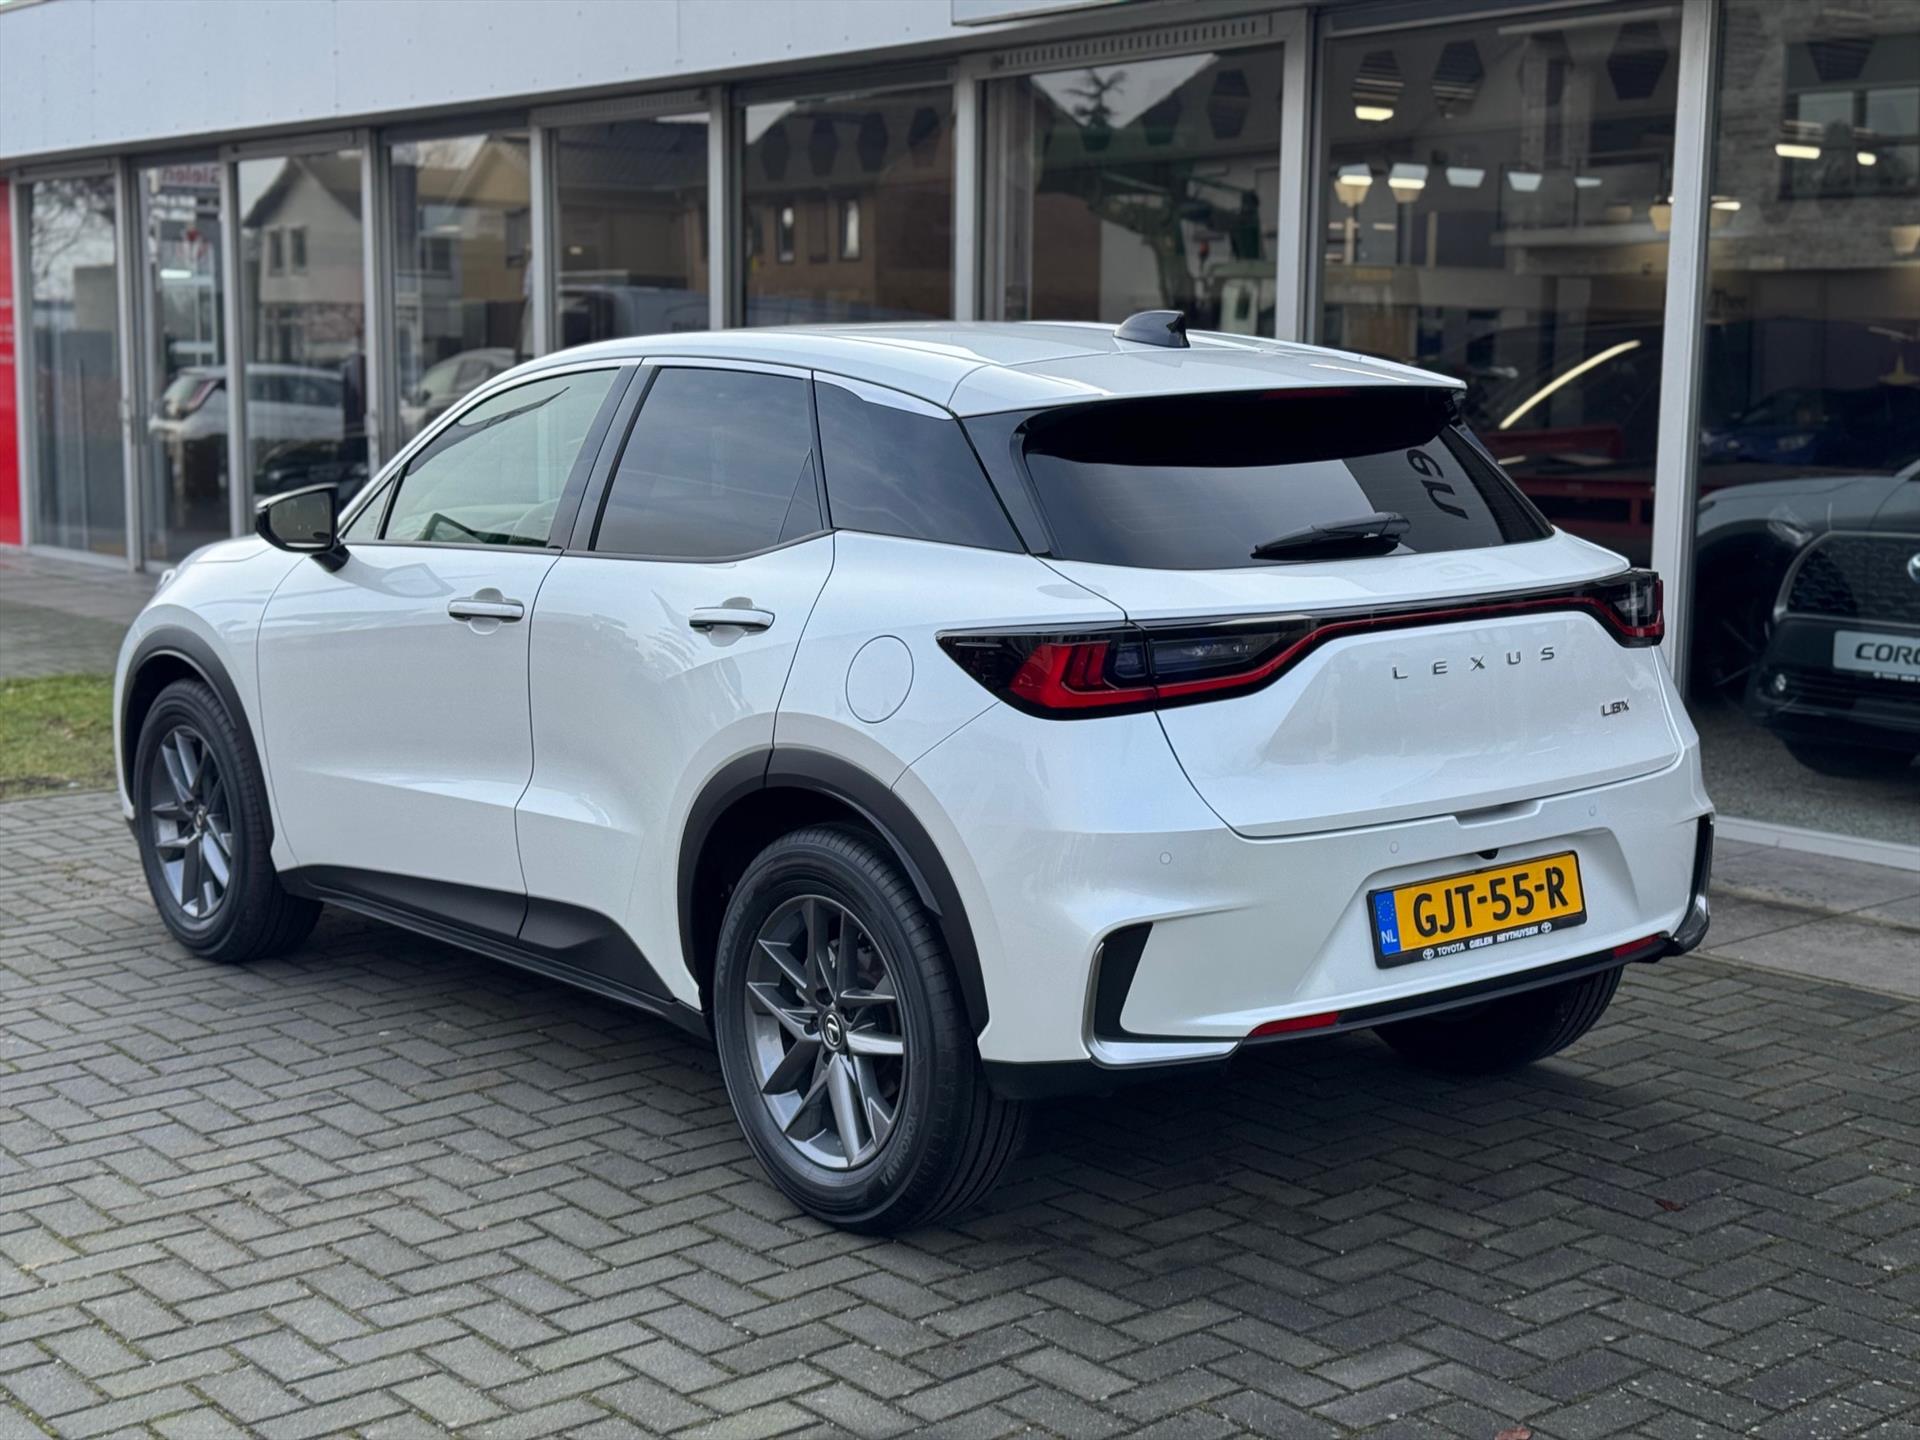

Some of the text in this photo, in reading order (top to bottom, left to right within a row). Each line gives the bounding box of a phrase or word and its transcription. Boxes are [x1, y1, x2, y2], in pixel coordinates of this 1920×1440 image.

[1393, 646, 1556, 680] LEXUS
[1601, 699, 1630, 717] LBX
[1413, 866, 1569, 938] GJT-55-R
[1381, 929, 1397, 945] NL
[1437, 925, 1538, 956] TOYOTA GIELEN HEYTHUYSEN
[881, 1115, 917, 1185] YOKOHAMA
